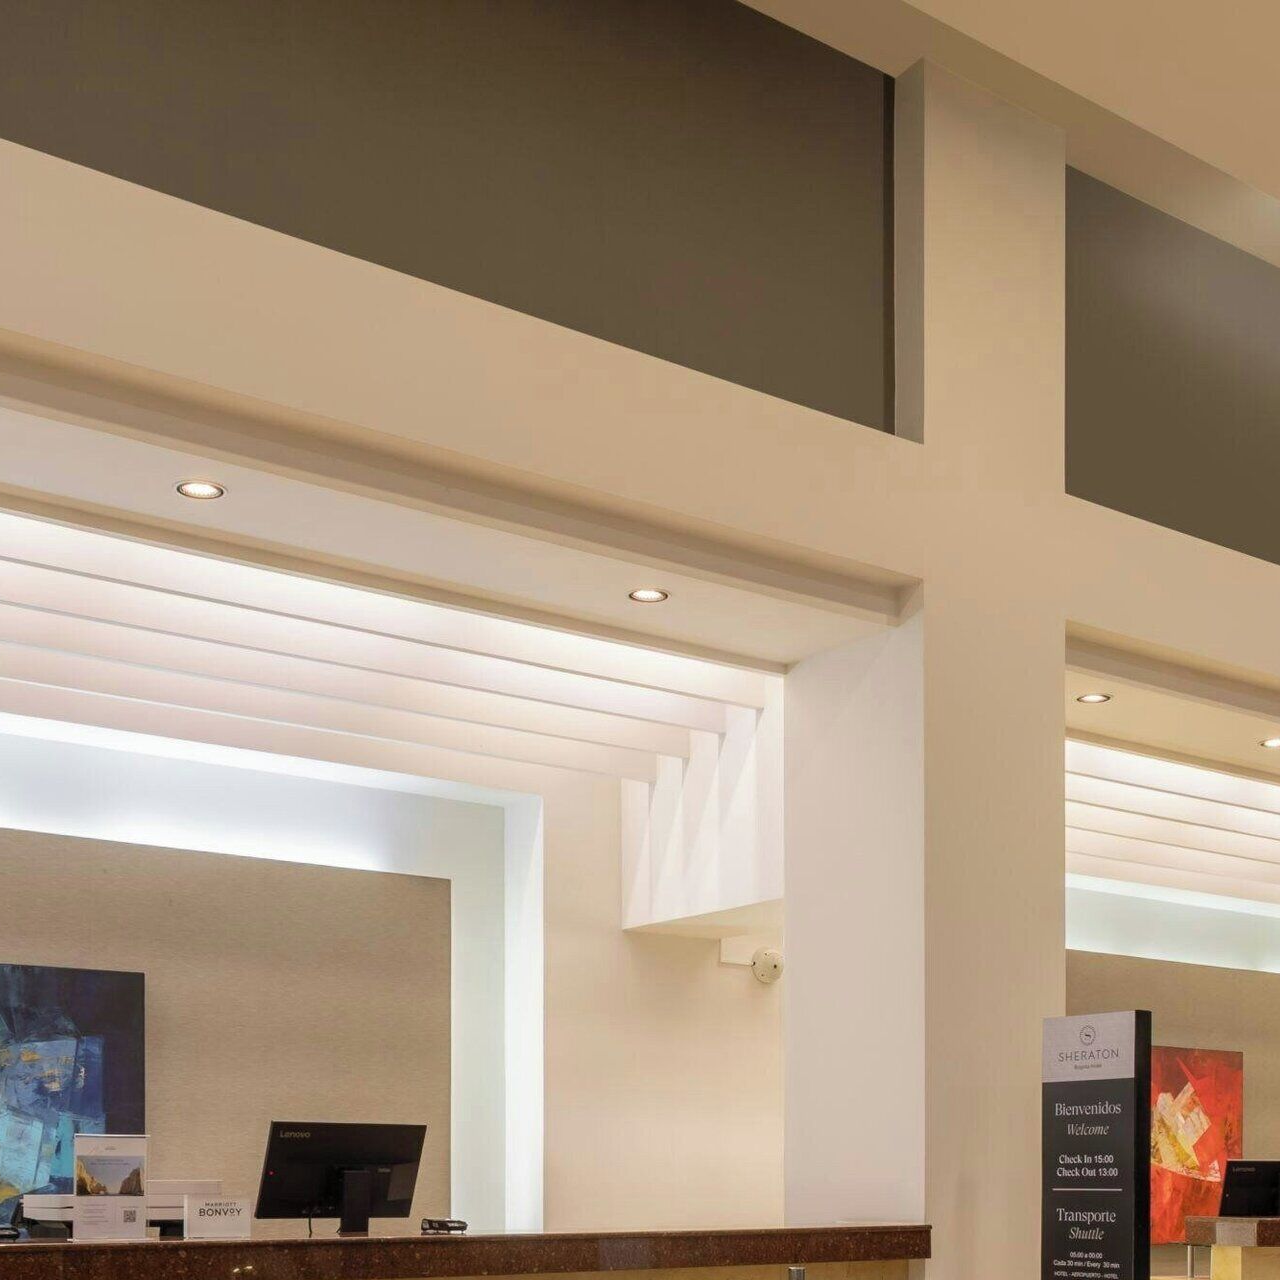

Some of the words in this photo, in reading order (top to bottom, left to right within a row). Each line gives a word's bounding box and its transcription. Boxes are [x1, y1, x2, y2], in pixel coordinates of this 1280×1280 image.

[1057, 1048, 1119, 1062] SHERATON
[1055, 1100, 1122, 1116] Bienvenidos
[279, 1130, 311, 1138] Lenovo
[1067, 1123, 1110, 1136] Welcome
[1058, 1154, 1083, 1164] Check
[1083, 1154, 1092, 1164] In
[1094, 1154, 1114, 1164] 15:00
[1056, 1167, 1080, 1177] Check
[1081, 1167, 1096, 1177] Out
[1098, 1167, 1119, 1177] 13:00
[198, 1208, 242, 1217] BONVOY
[1056, 1208, 1117, 1225] Transporte
[1068, 1226, 1105, 1240] Shuttle
